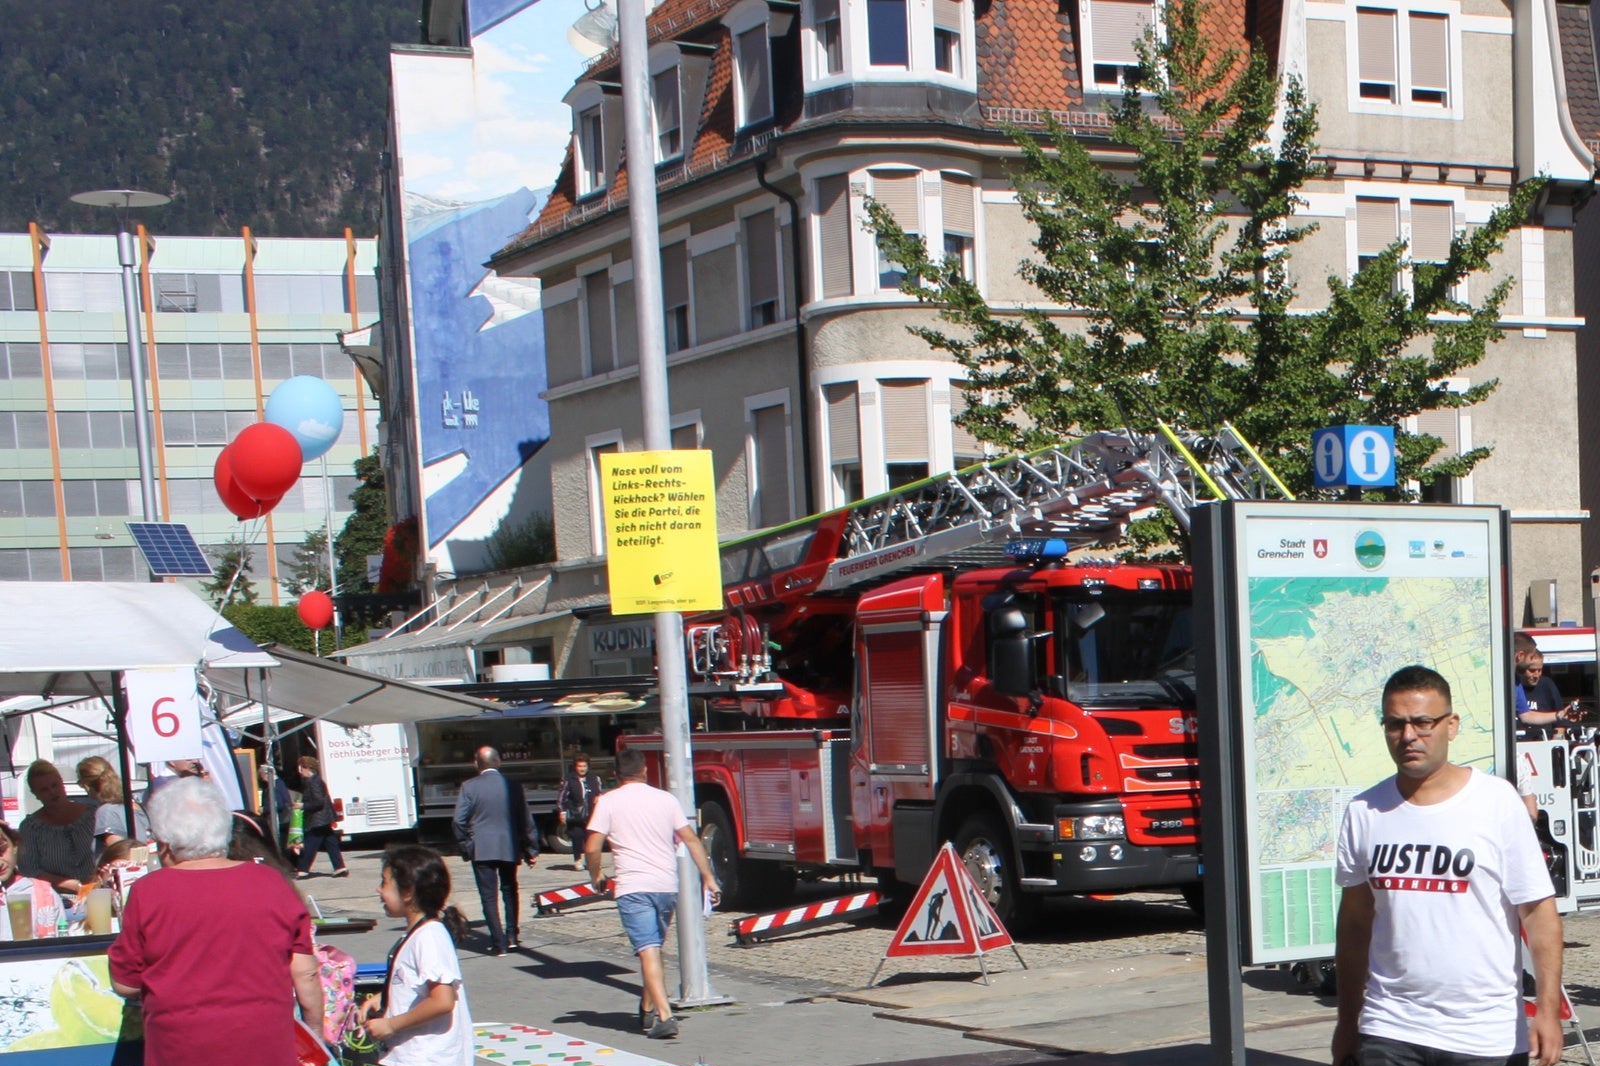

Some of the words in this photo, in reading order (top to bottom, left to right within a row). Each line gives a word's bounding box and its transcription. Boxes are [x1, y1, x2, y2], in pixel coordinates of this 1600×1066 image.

[612, 467, 637, 476] Nase
[639, 465, 658, 475] voll
[660, 466, 683, 474] vom
[612, 479, 687, 490] Links-Rechts-
[613, 493, 665, 505] Hickhack?
[667, 492, 705, 502] Wählen
[614, 508, 629, 519] Sie
[631, 508, 647, 518] die
[648, 506, 684, 517] Partei,
[685, 506, 701, 516] die
[615, 522, 637, 533] sich
[639, 521, 667, 532] nicht
[669, 520, 702, 530] daran
[616, 536, 665, 548] beteiligt.
[1279, 538, 1306, 548] Stadt
[839, 557, 878, 576] FEUERWEHR
[879, 545, 916, 565] GRENCHEN
[1257, 549, 1305, 559] Grenchen
[593, 627, 651, 652] KUONI
[151, 697, 180, 738] 6
[328, 740, 350, 748] boss
[951, 734, 960, 752] 3
[1368, 844, 1432, 874] JUST
[1432, 845, 1476, 878] DO
